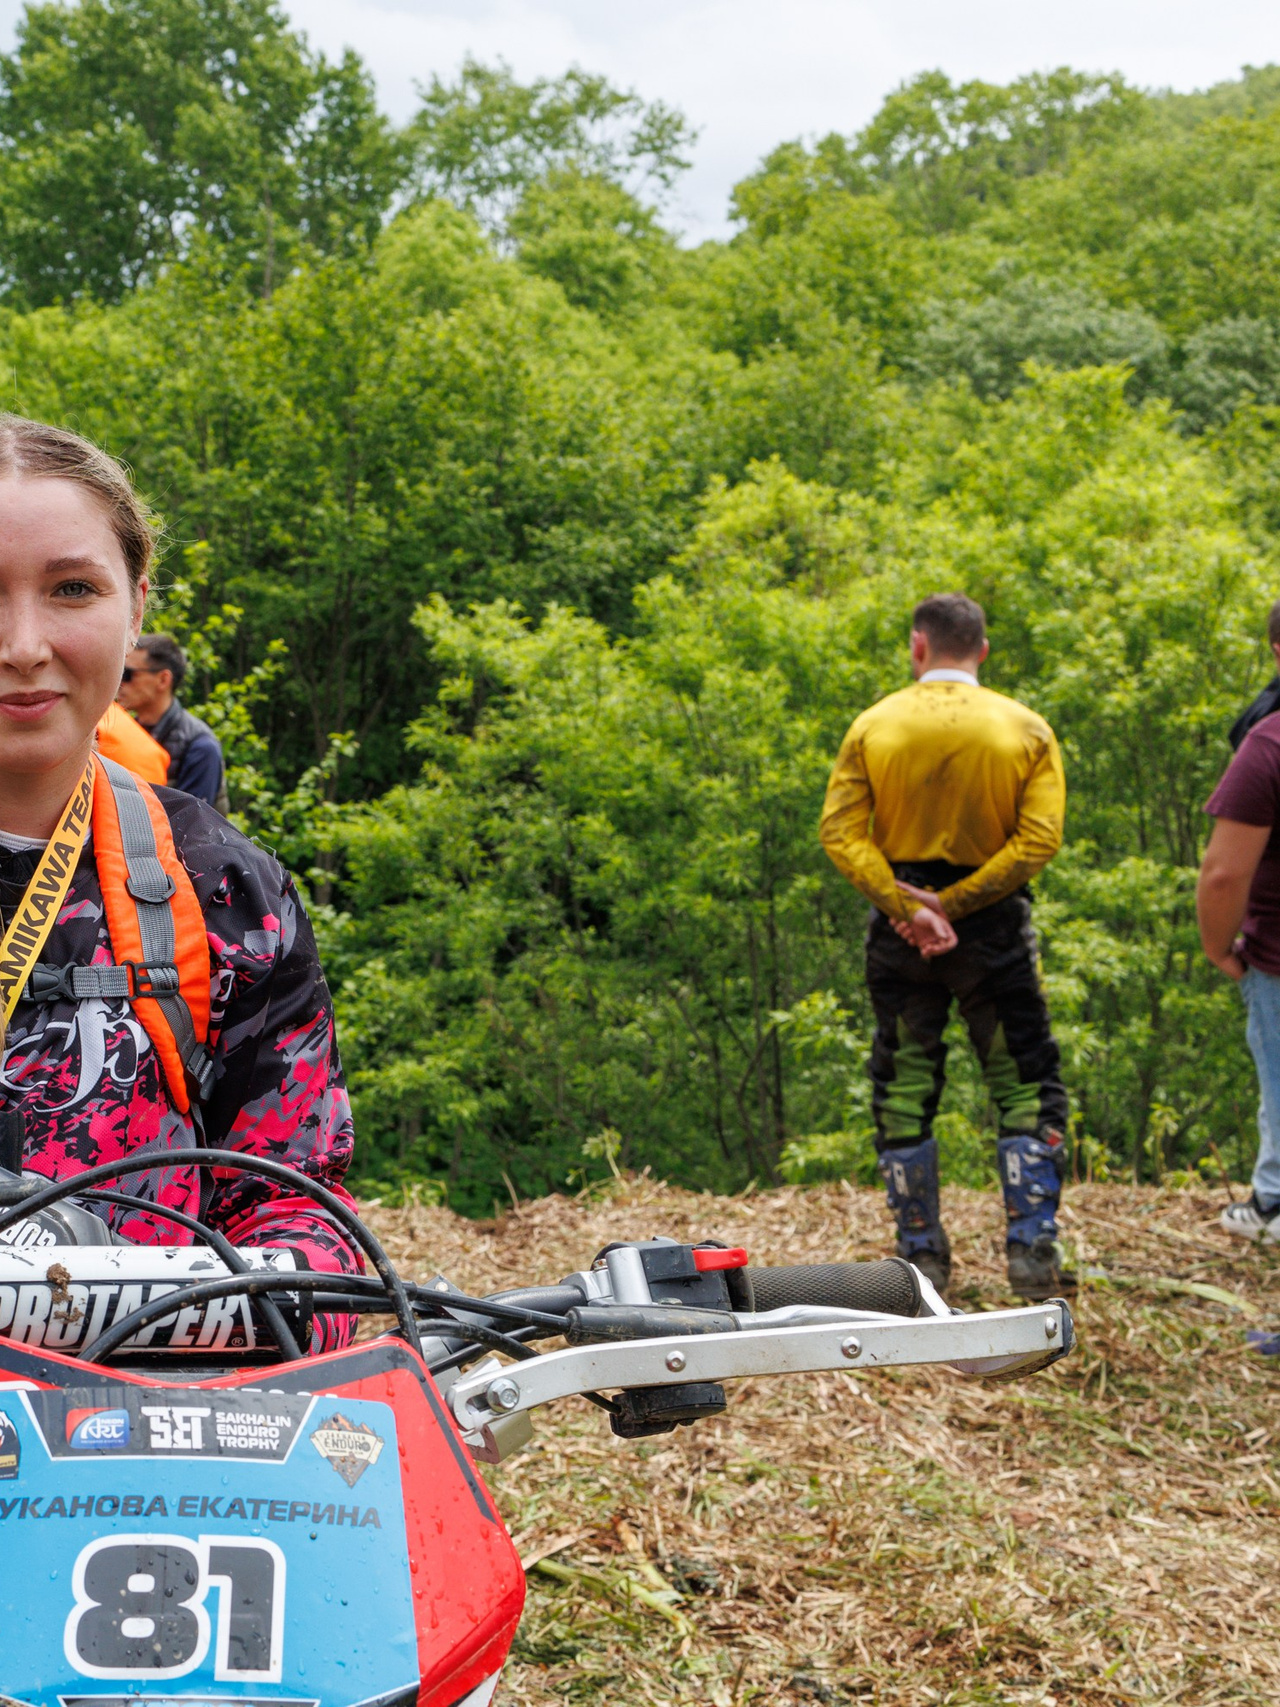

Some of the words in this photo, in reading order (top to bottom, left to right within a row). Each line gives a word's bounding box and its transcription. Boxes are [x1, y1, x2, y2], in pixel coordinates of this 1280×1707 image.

[216, 1411, 291, 1428] SAKHALIN
[217, 1424, 280, 1438] ENDURO
[217, 1436, 280, 1450] TROPHY
[176, 1495, 382, 1529] ЕКАТЕРИНА
[64, 1533, 286, 1683] 81
